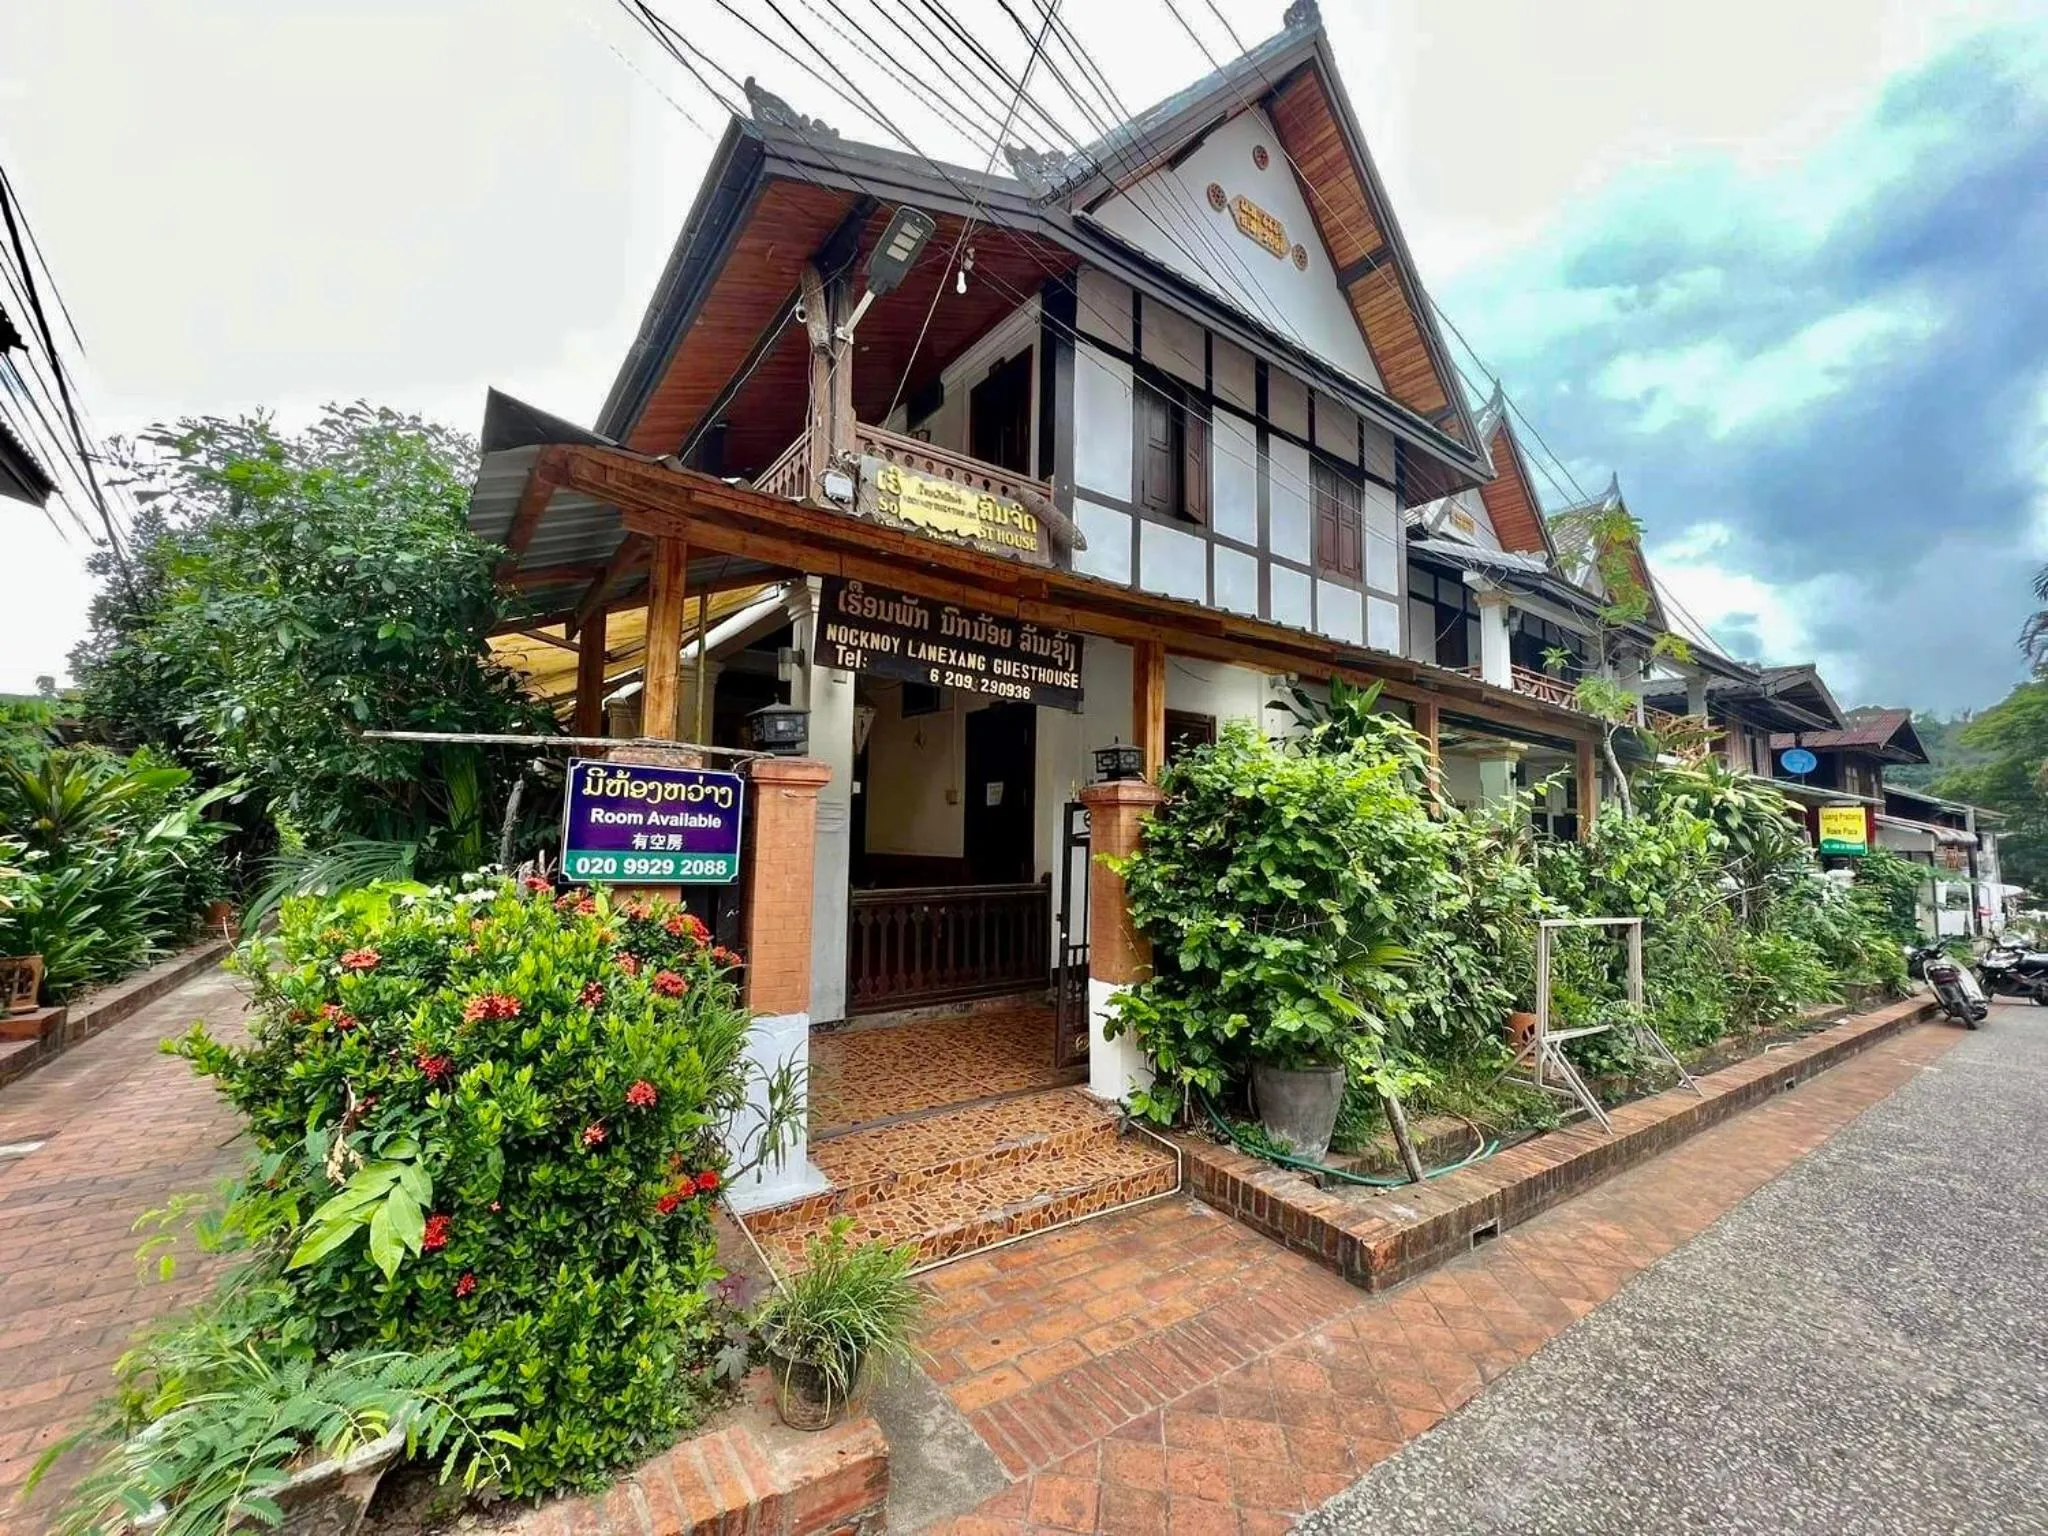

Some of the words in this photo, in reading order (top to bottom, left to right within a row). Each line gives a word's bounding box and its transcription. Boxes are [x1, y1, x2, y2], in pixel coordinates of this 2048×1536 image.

[997, 529, 1037, 551] HOUSE
[826, 623, 901, 654] NOCKNOY
[908, 639, 986, 672] LANEXANG
[993, 656, 1079, 689] GUESTHOUSE
[835, 645, 869, 669] Tel:
[591, 808, 643, 825] Room
[647, 811, 722, 828] Available
[632, 832, 683, 851] 有空房
[576, 857, 617, 875] 020
[623, 857, 674, 875] 9929
[680, 859, 727, 876] 2088
